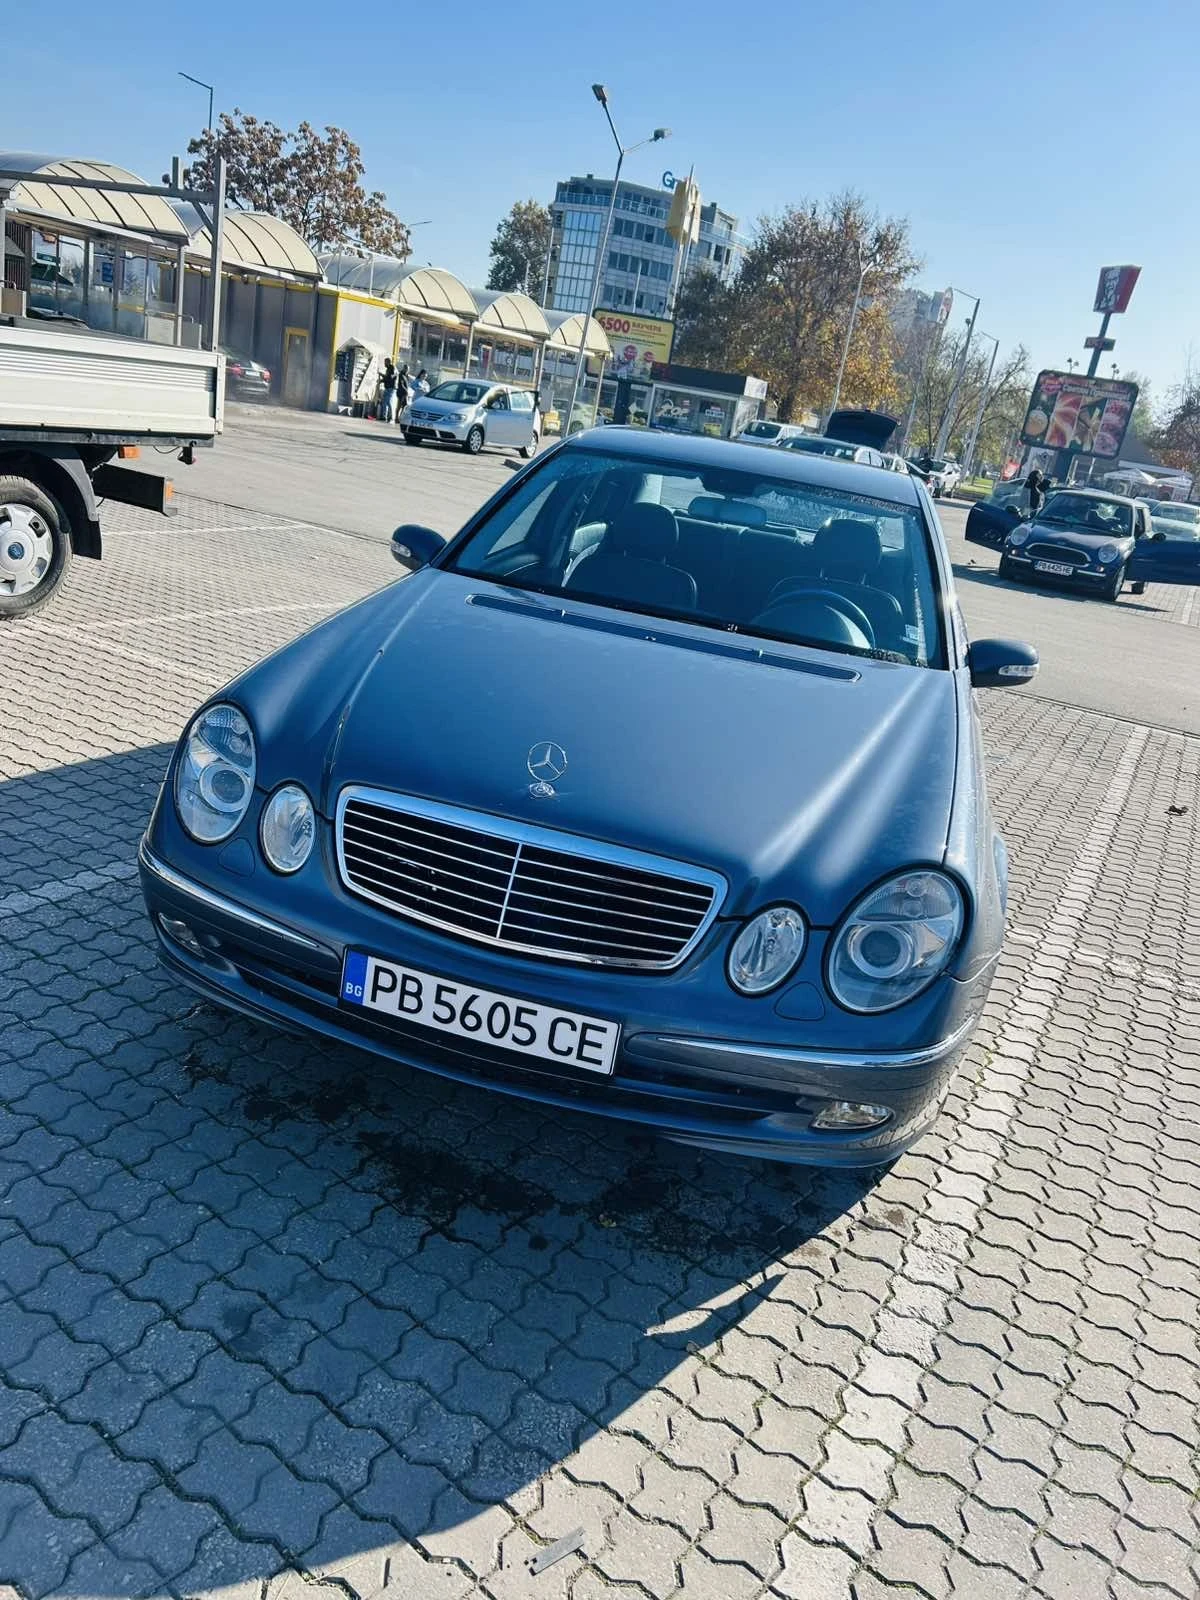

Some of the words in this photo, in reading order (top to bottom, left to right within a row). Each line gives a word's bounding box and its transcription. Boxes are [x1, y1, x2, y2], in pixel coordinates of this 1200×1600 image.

[345, 982, 362, 997] BG
[370, 965, 423, 1014] PB
[432, 984, 538, 1046] 5605
[547, 1017, 607, 1066] CE
